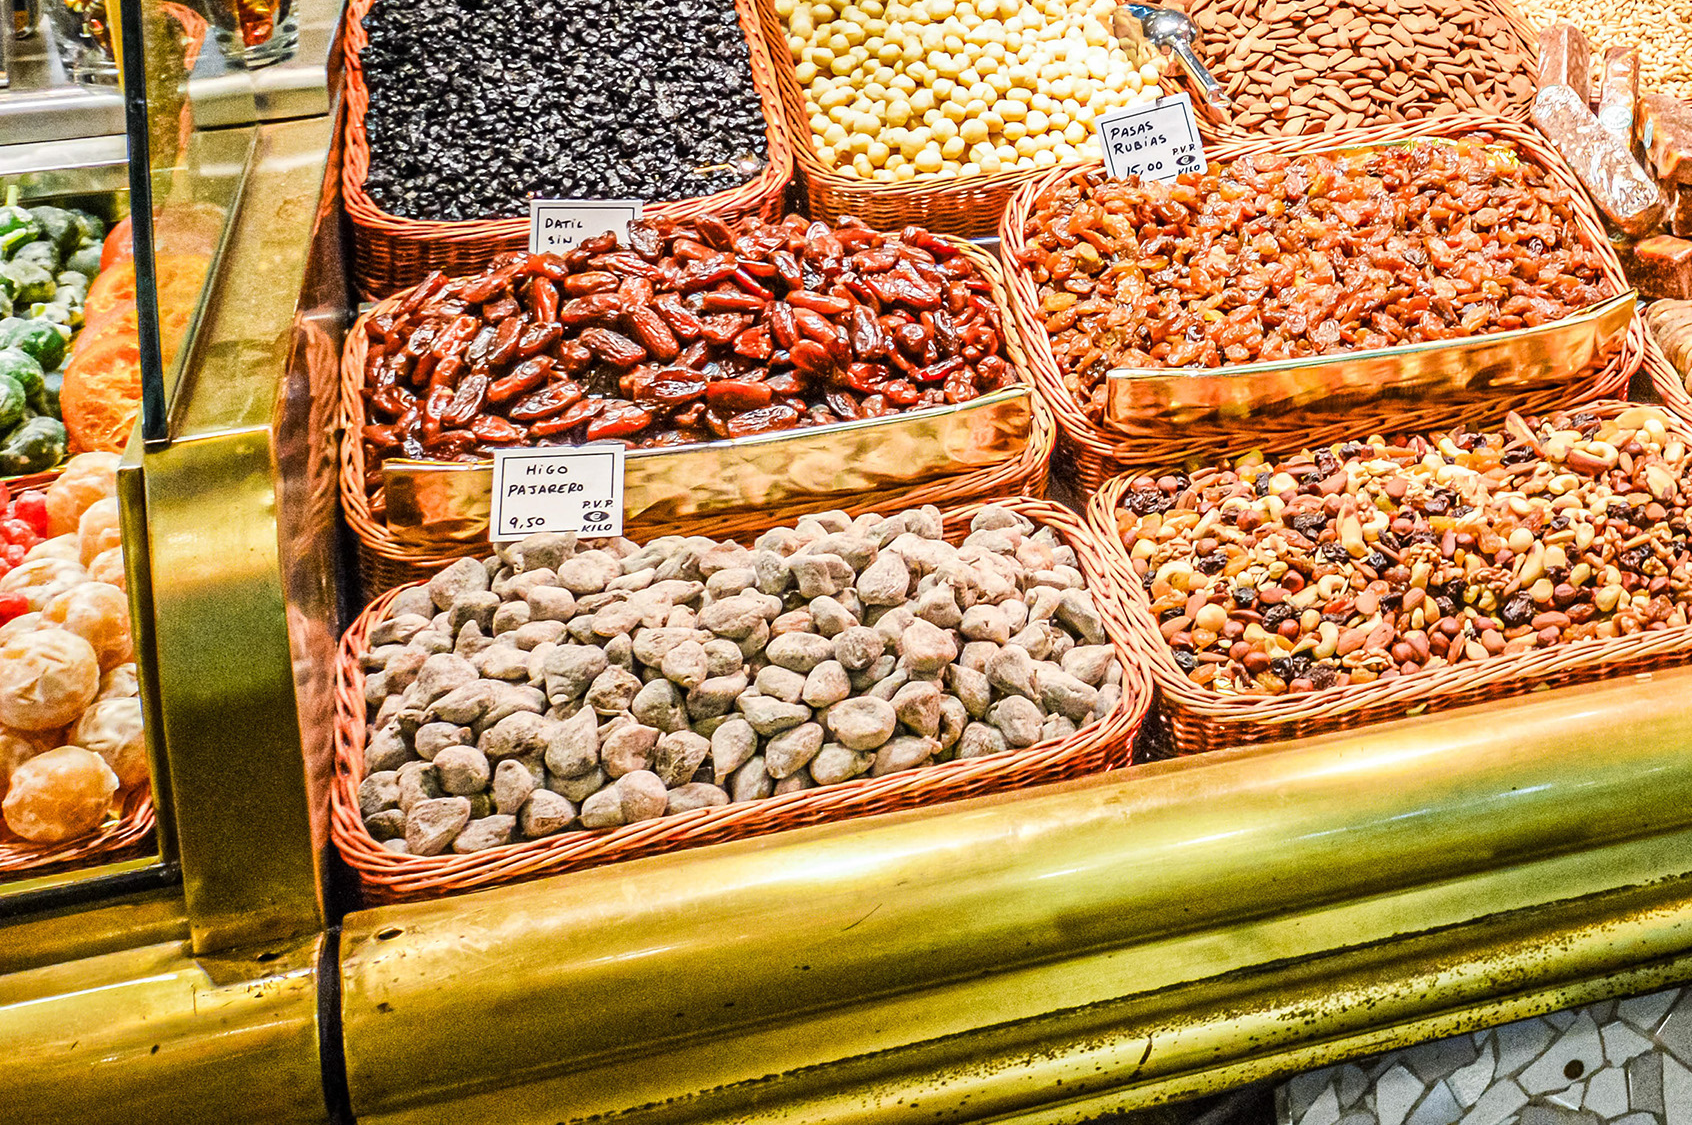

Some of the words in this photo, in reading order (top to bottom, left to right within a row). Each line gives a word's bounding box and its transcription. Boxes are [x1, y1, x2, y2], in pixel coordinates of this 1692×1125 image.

[1110, 120, 1154, 141] PASAS
[507, 482, 584, 498] PAJARERO
[509, 516, 546, 530] 9,50
[581, 523, 613, 533] KILO
